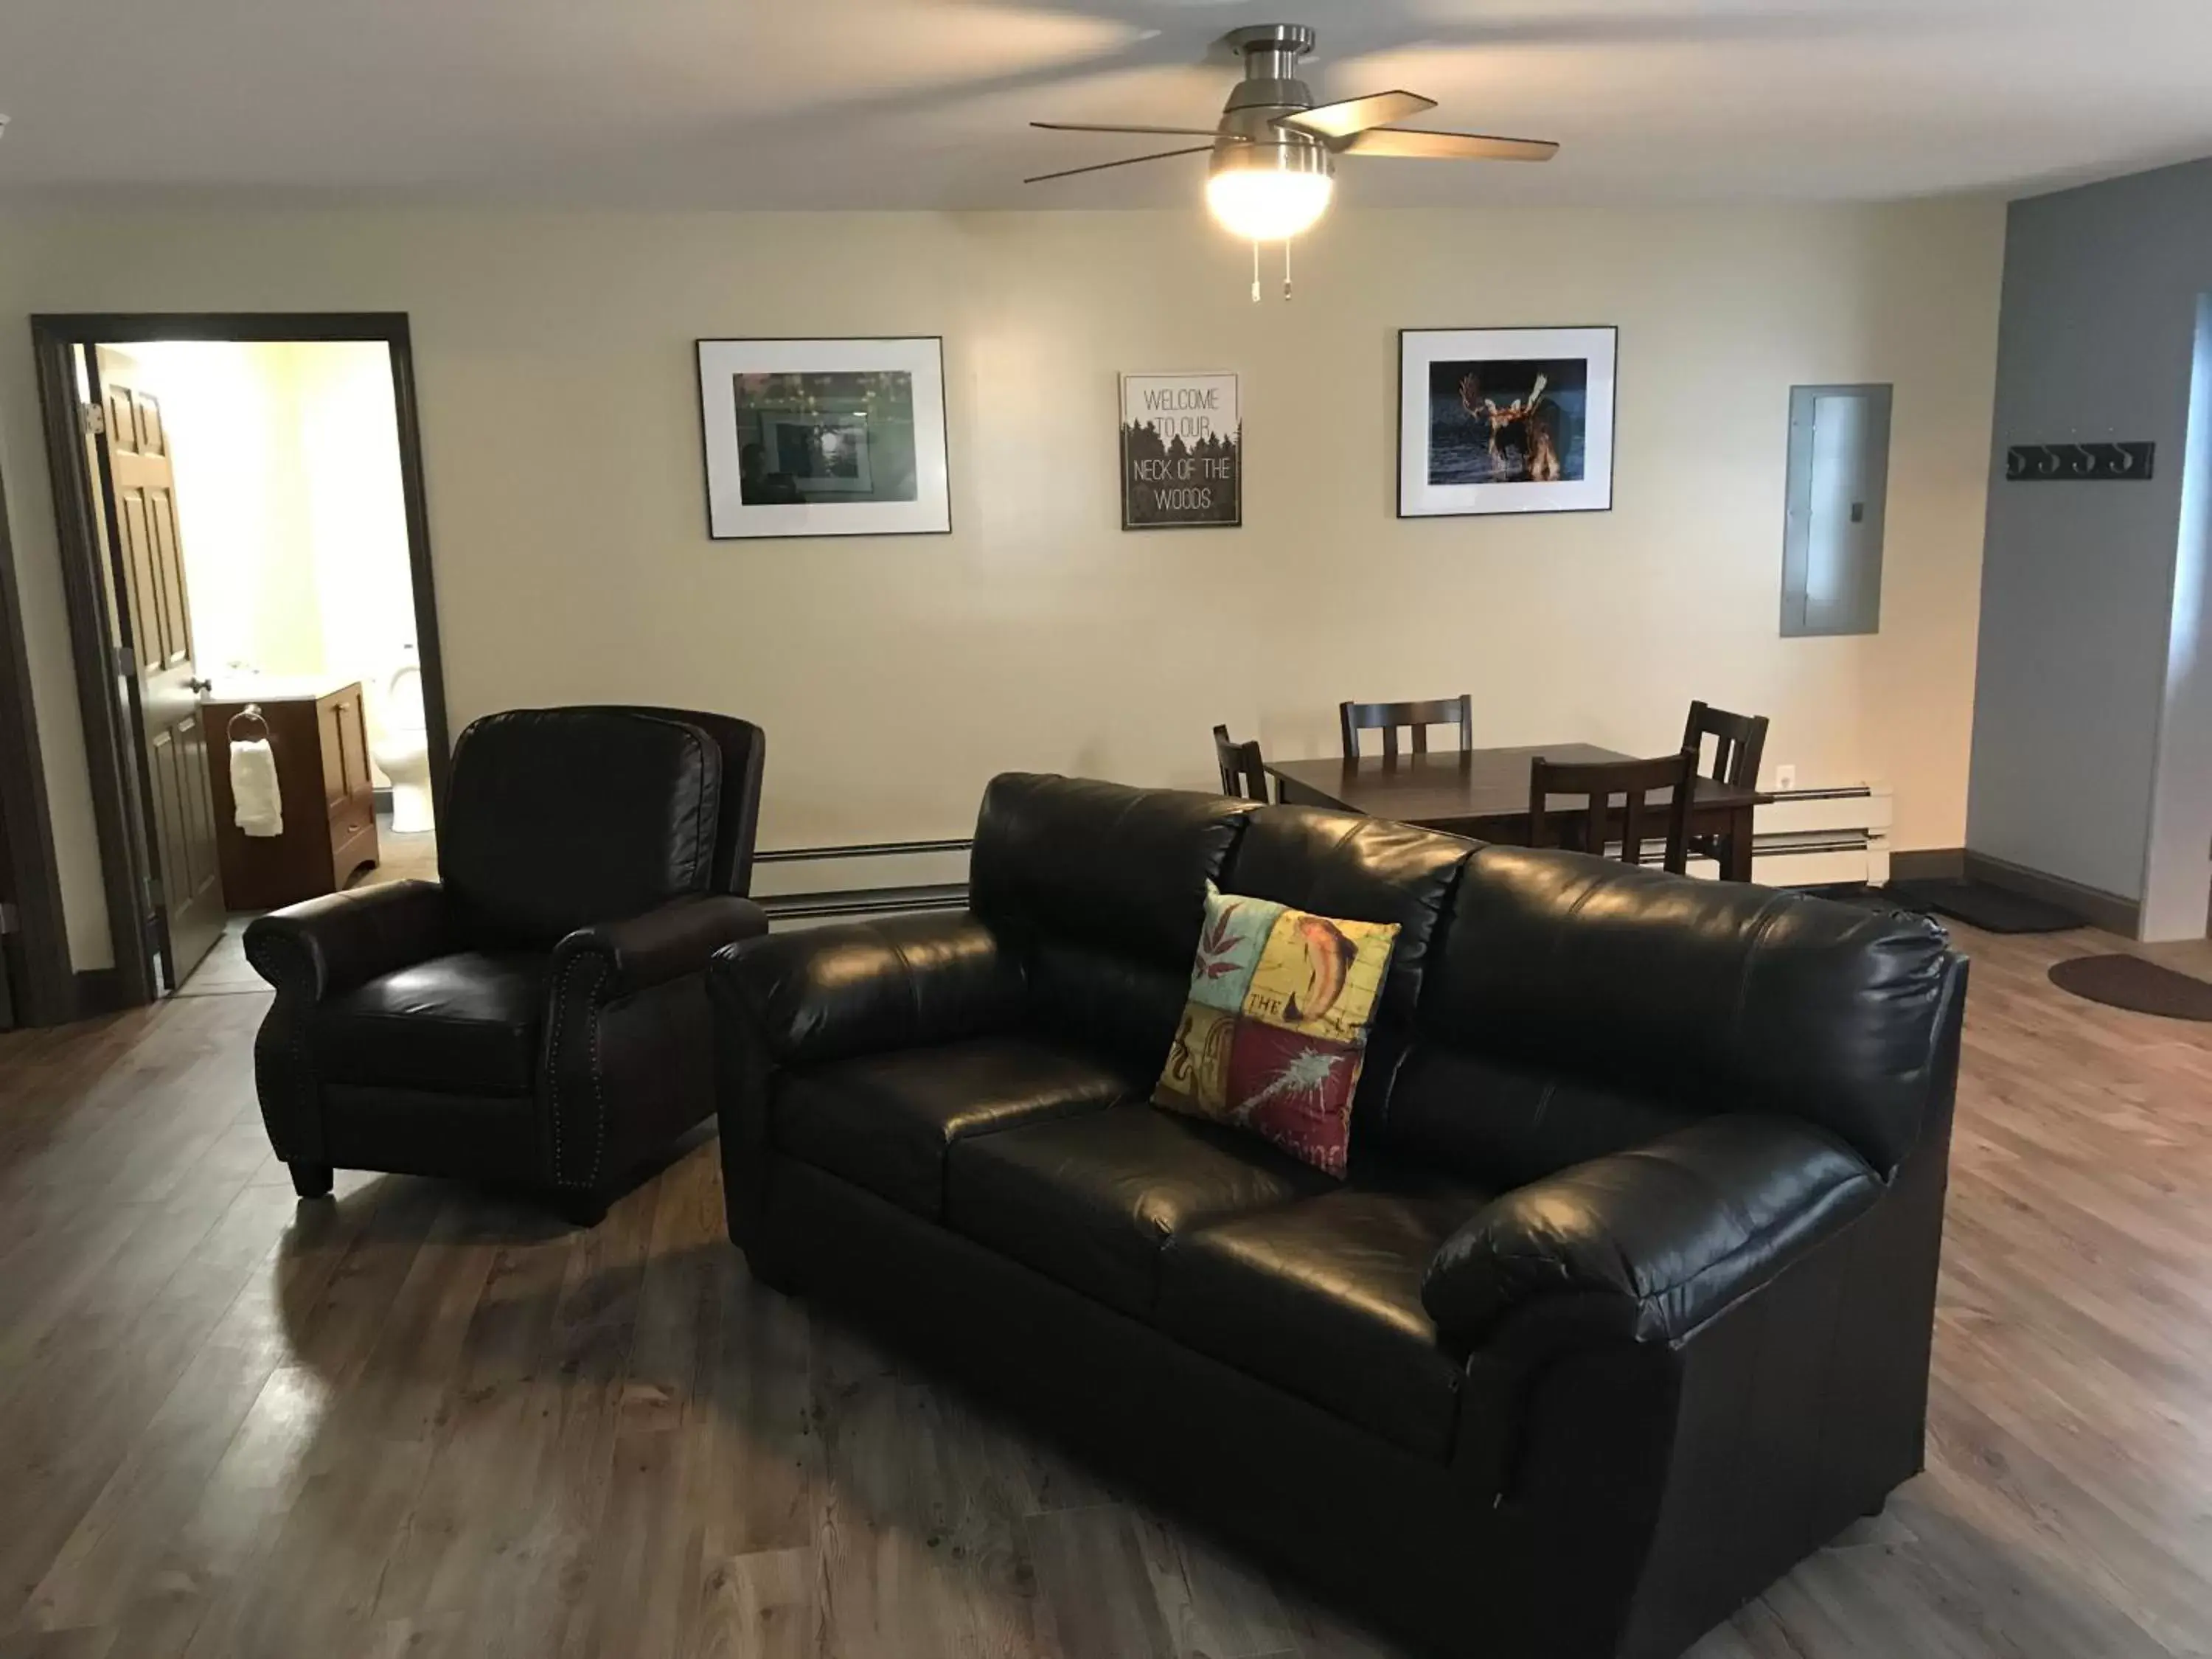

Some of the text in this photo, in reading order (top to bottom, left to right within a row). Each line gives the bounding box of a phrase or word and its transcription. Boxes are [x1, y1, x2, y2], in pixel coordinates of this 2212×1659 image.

[1144, 389, 1219, 410] WELCOME
[1155, 416, 1210, 437] TO OUR
[1134, 457, 1230, 481] NECK OF THE
[1154, 487, 1211, 510] WOODS
[1248, 993, 1281, 1015] THE
